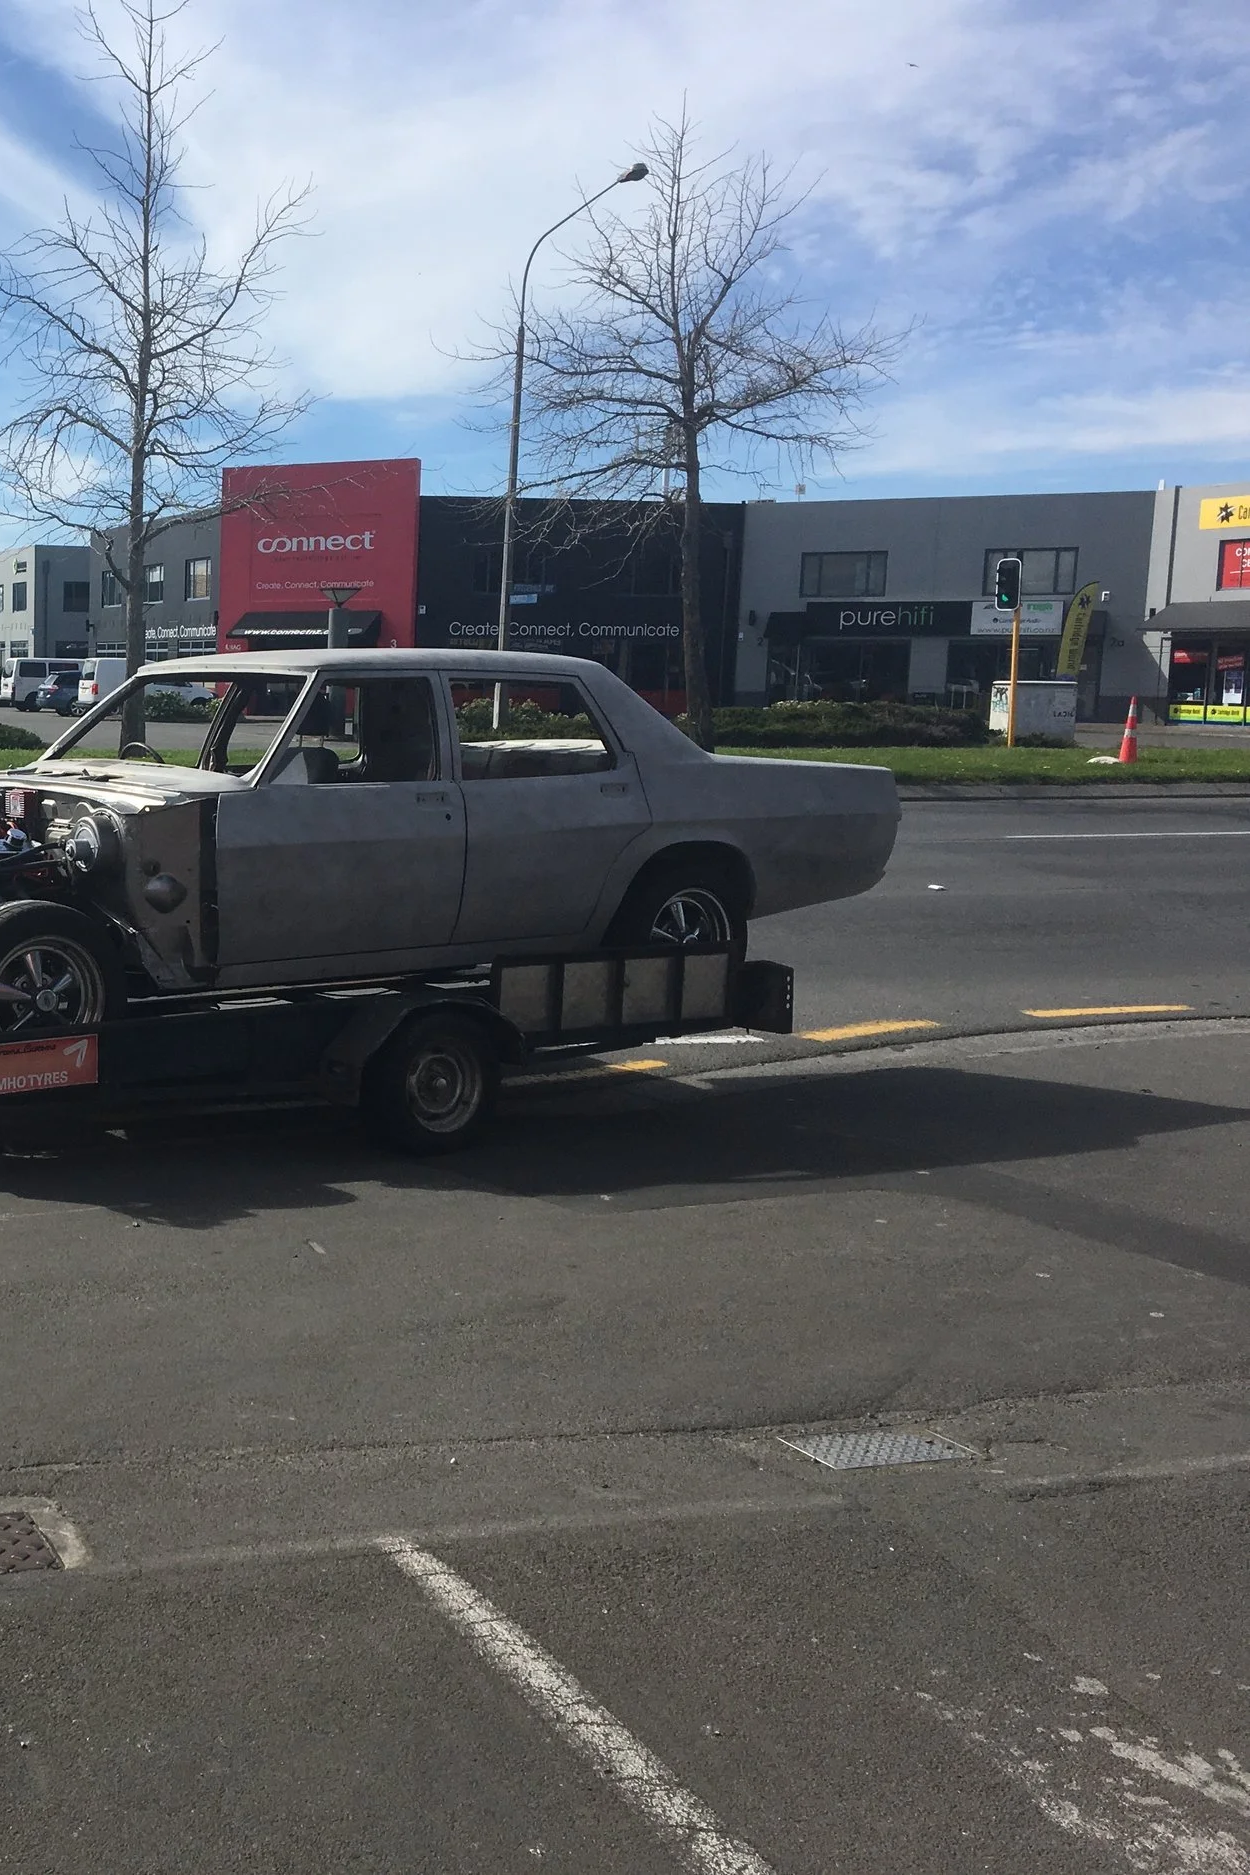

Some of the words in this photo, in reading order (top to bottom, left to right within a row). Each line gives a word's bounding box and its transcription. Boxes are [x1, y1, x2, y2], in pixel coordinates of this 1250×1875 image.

[257, 531, 374, 553] connect
[320, 580, 374, 588] Communicate
[839, 606, 934, 630] purehifi
[180, 624, 217, 637] Communicate
[449, 622, 499, 636] Create
[509, 622, 575, 637] Connect,
[579, 622, 680, 637] Communicate
[390, 639, 397, 649] 3
[28, 1071, 68, 1087] TYRES
